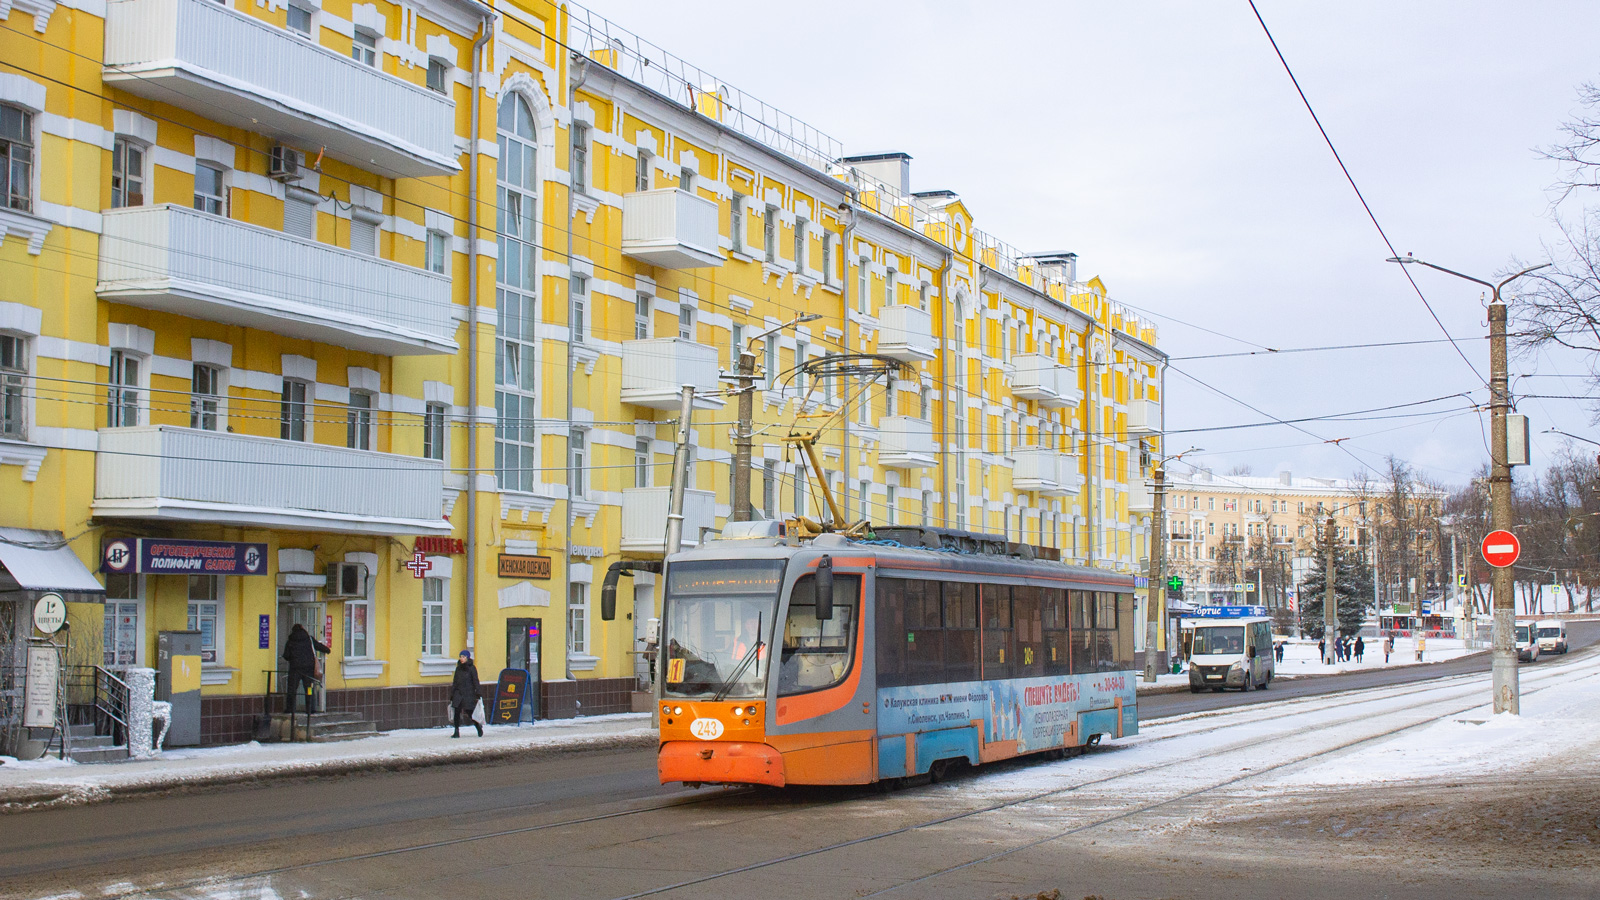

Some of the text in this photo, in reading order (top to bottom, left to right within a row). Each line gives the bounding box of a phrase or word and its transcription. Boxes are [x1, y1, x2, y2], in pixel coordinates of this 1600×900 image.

[150, 544, 236, 558] ОРТОПЕДИЧЕСКИЙ
[415, 536, 465, 554] АПТЕКА
[151, 557, 236, 571] ПОЛИФАРМ САЛОН
[500, 557, 550, 575] ЖЕНСКАЯ ОДЕЖДА
[38, 616, 62, 625] ЦВЕТЫ
[673, 660, 680, 681] 1
[890, 697, 918, 709] Калужская
[919, 697, 939, 705] клиника
[1024, 684, 1052, 707] СПЕШИТЕ
[697, 721, 717, 737] 243
